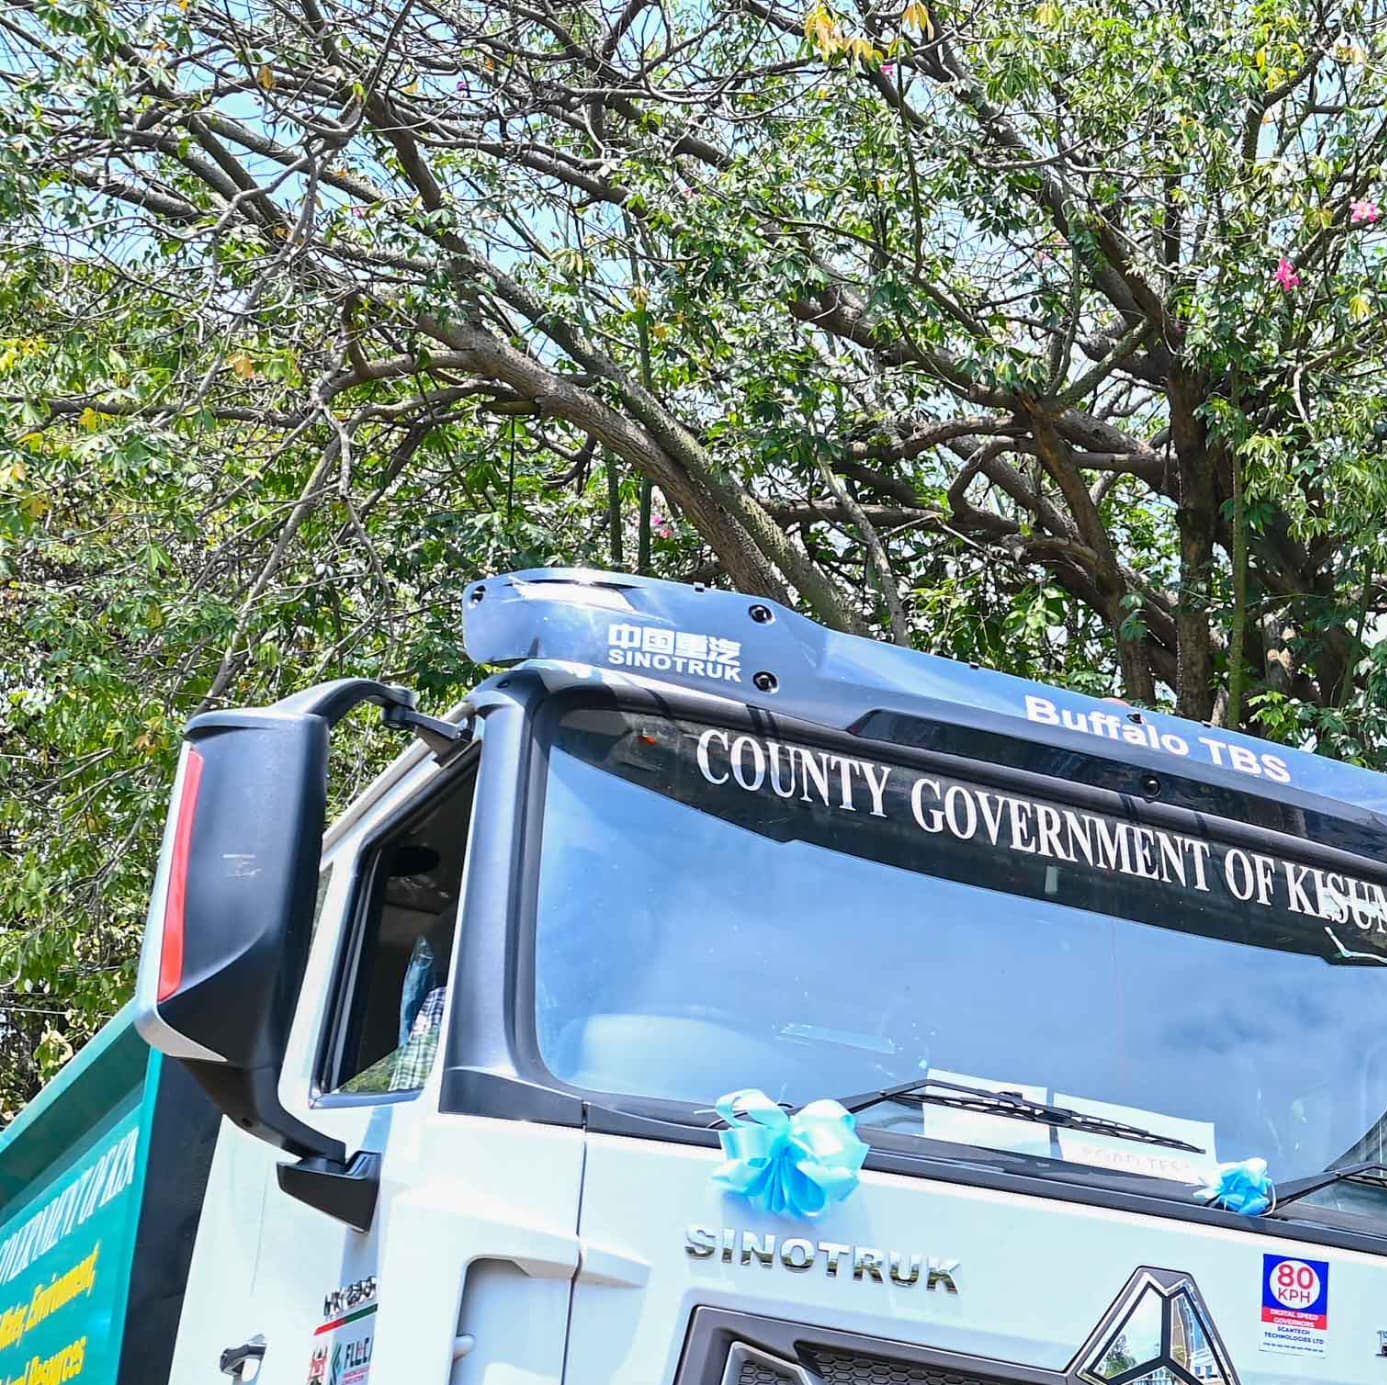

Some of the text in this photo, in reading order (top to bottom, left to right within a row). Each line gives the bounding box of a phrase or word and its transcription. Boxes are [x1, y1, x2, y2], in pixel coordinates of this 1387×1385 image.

[608, 624, 742, 666] 中国重汽
[608, 649, 742, 682] SINOTRUK
[1025, 695, 1292, 784] Buffalo TBS
[697, 729, 892, 818] COUNTY
[911, 778, 1211, 892] GOVERNMENT
[1224, 848, 1276, 906] OF
[684, 1223, 961, 1294] SINOTRUK
[1277, 1263, 1314, 1290] 80
[1277, 1287, 1311, 1304] KPH
